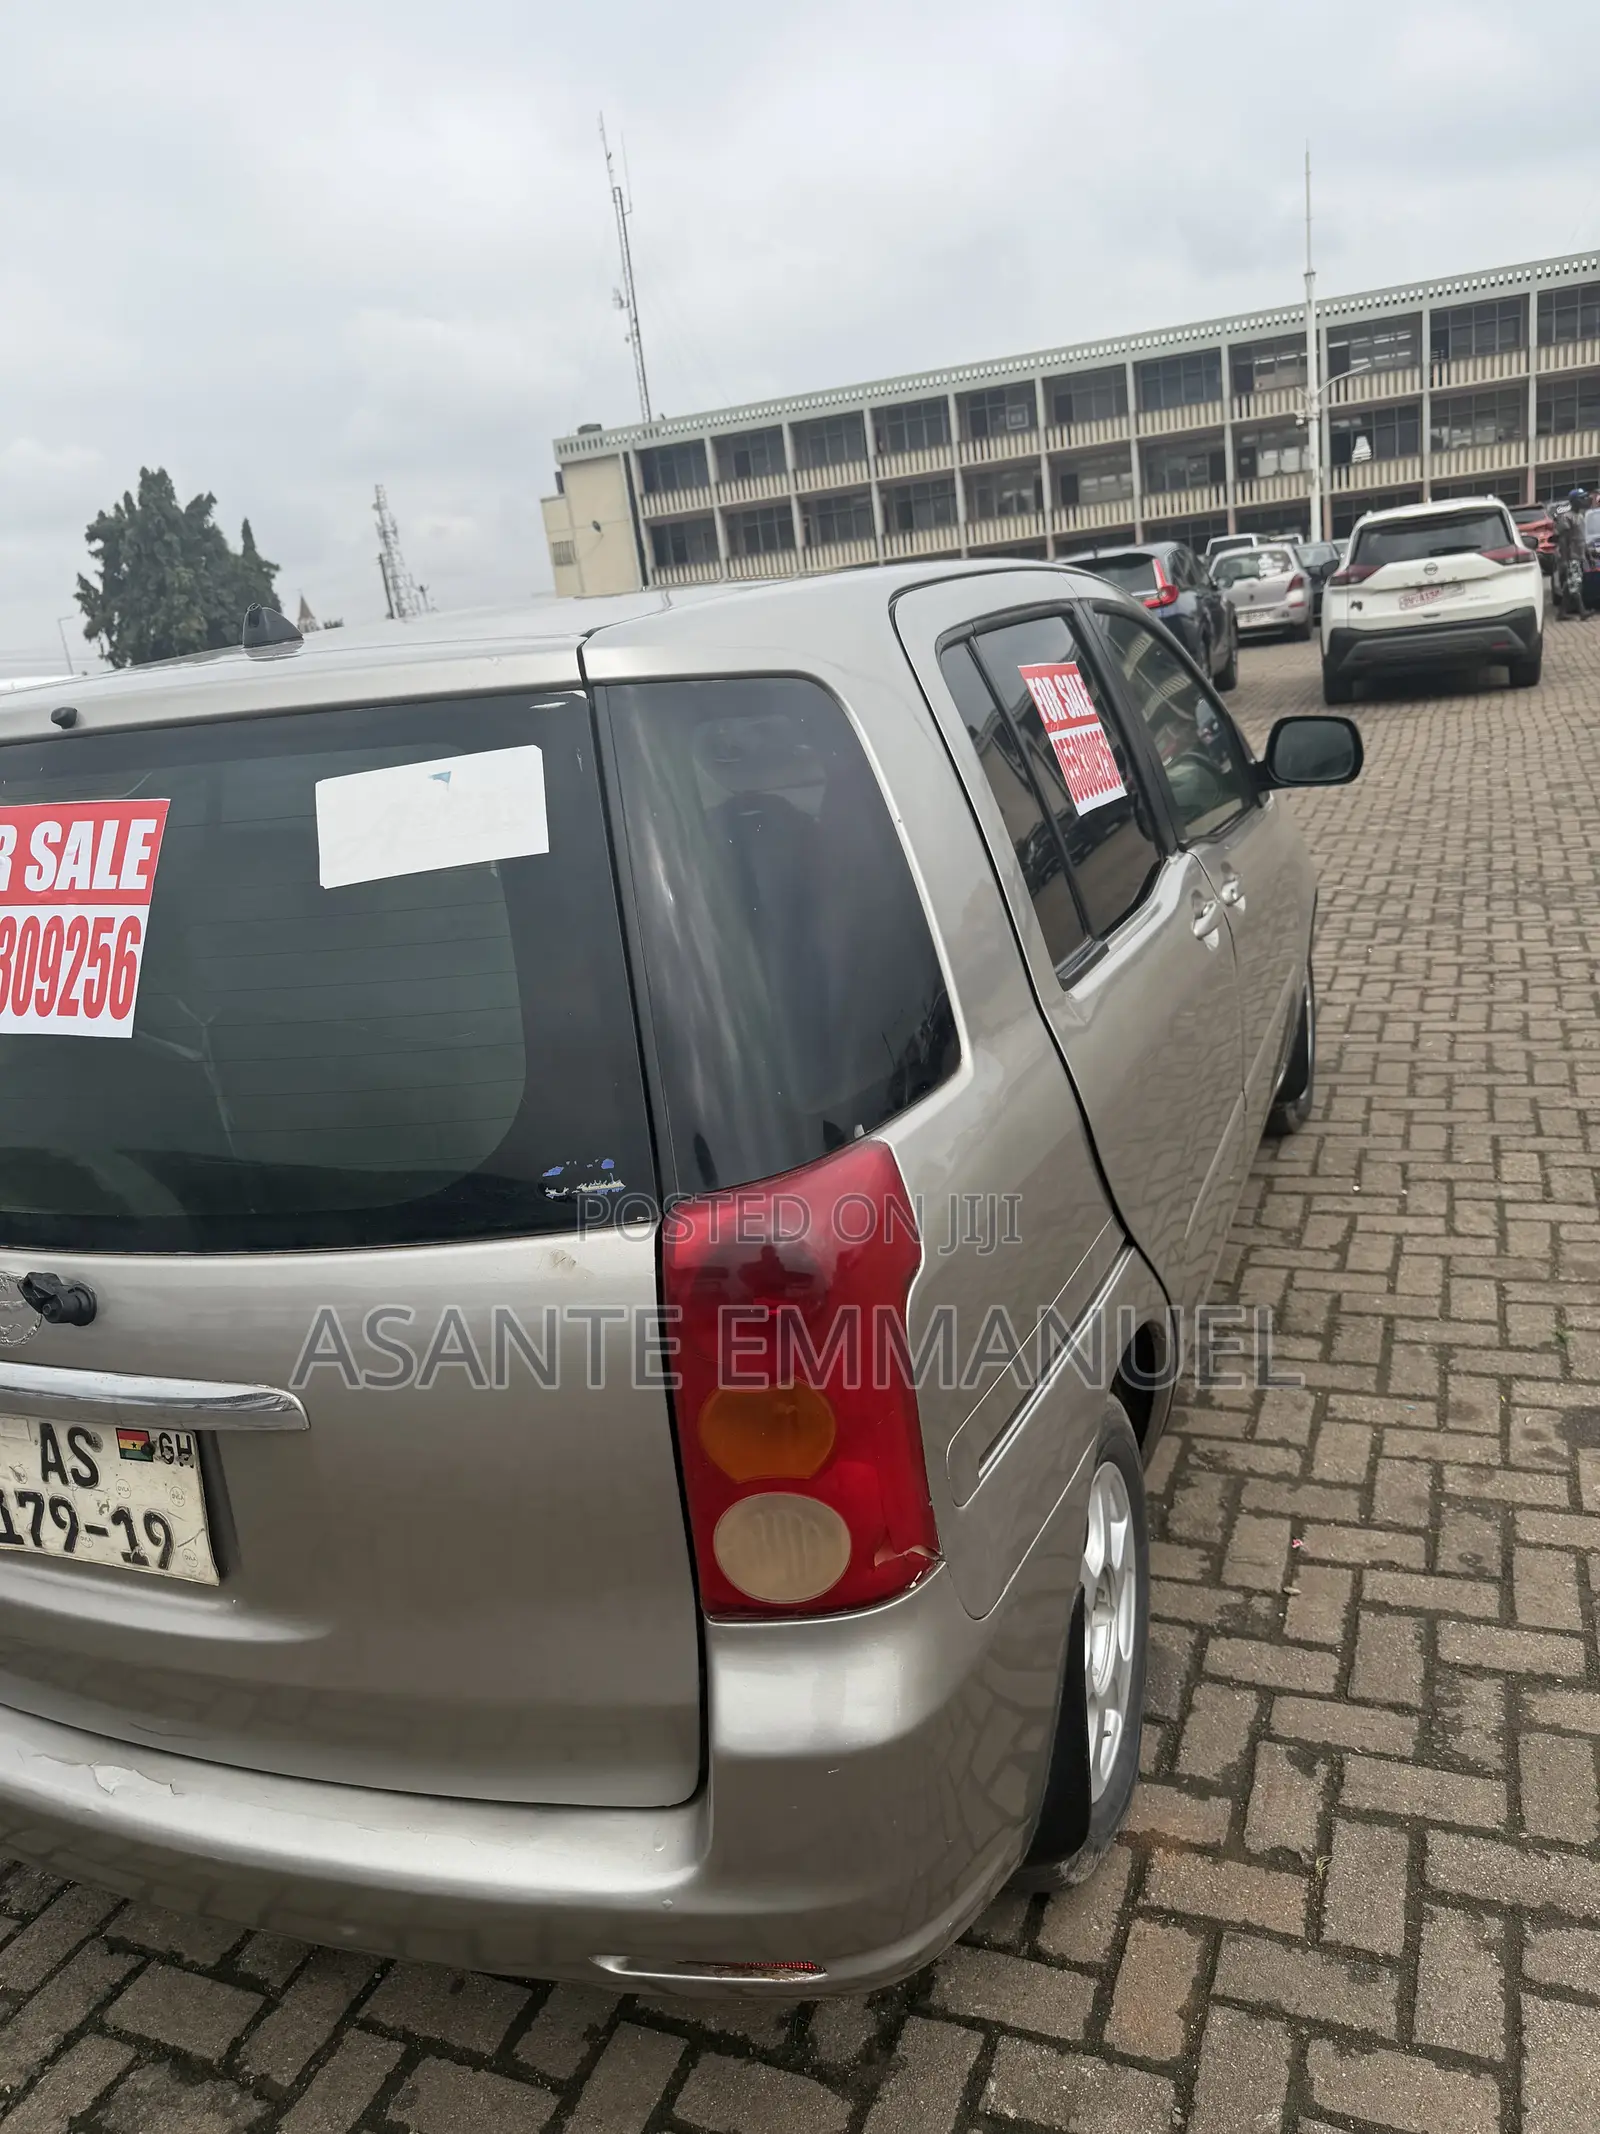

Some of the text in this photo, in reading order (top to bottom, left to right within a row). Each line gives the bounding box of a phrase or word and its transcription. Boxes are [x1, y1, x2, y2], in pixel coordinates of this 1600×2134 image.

[1026, 674, 1096, 723] FOR SALE
[1053, 729, 1121, 804] 0558309256
[25, 819, 157, 891] SALE
[40, 1423, 99, 1489] AS
[159, 1432, 194, 1468] GH
